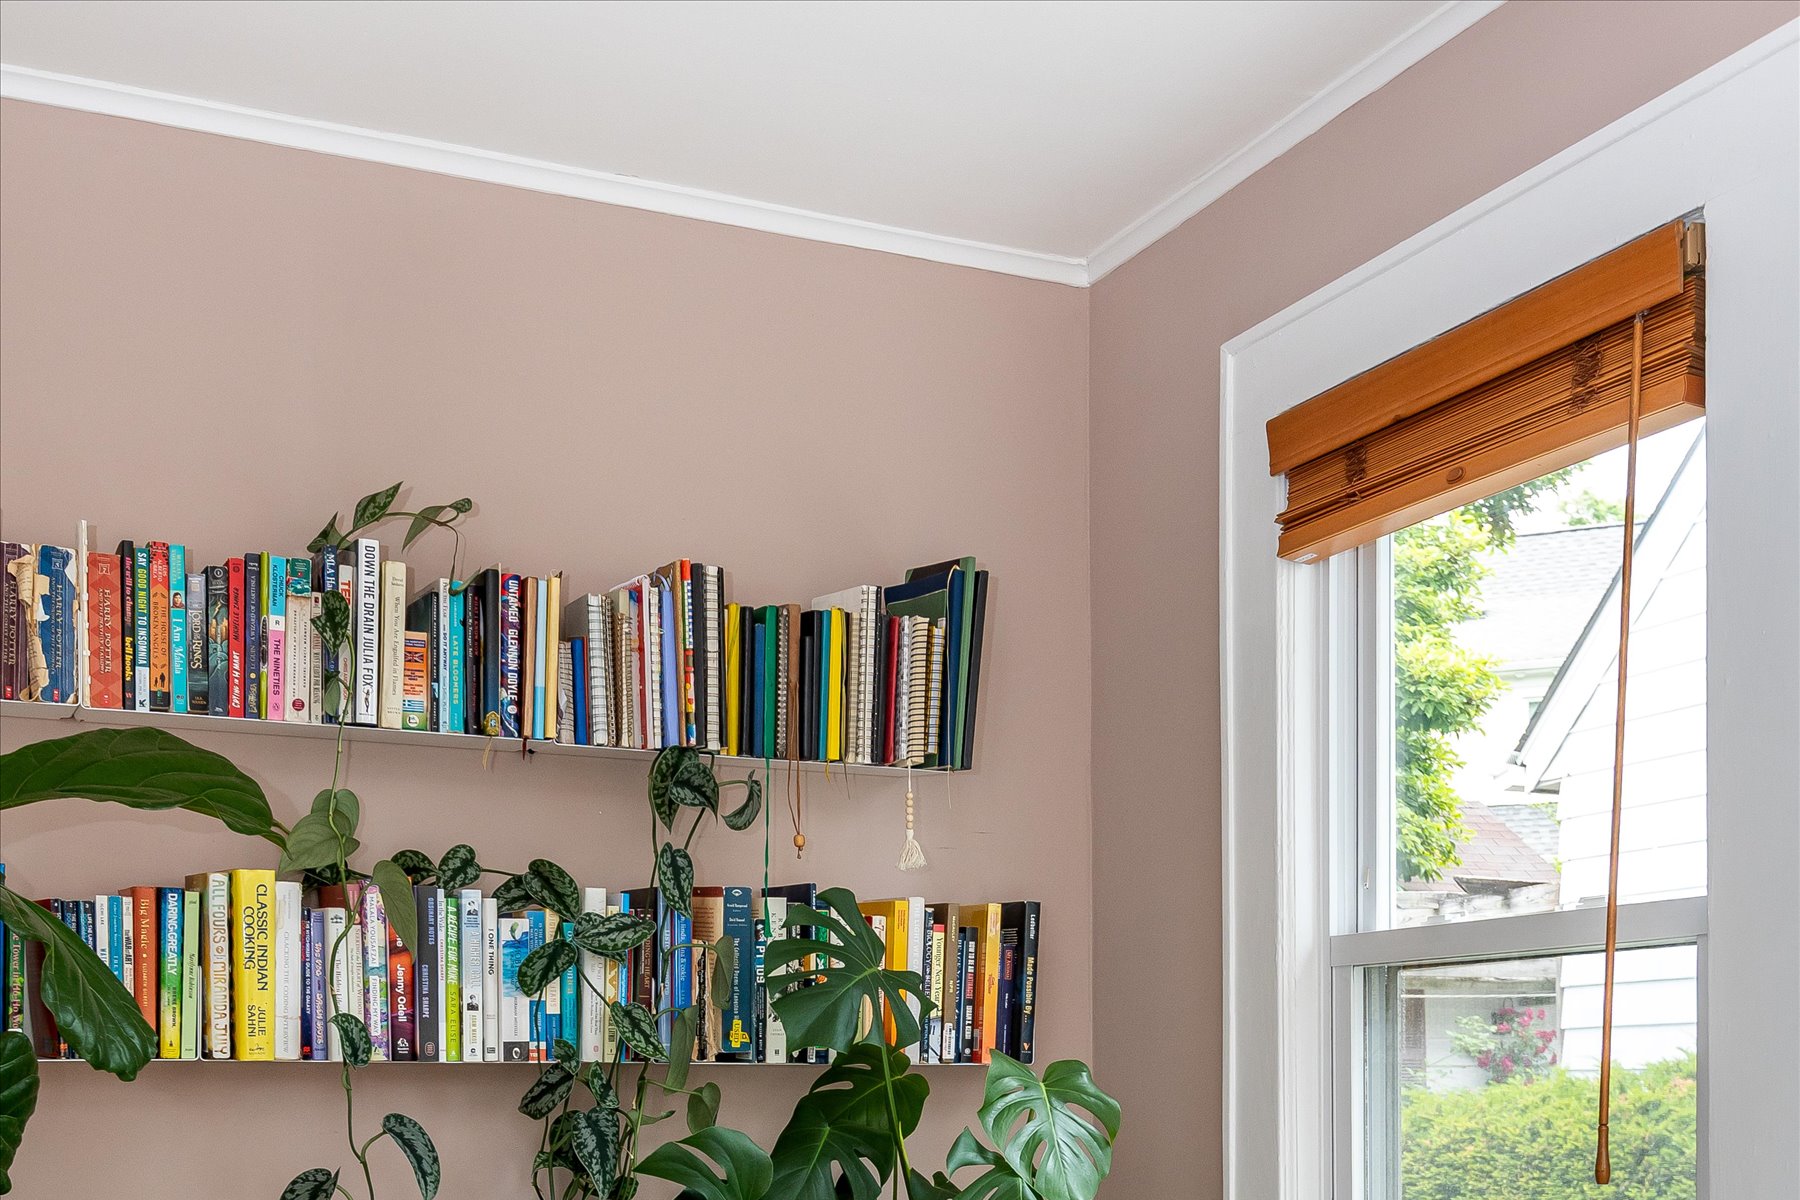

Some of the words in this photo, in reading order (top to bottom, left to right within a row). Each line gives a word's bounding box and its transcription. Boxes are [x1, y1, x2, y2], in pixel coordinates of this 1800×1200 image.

[137, 552, 147, 566] SAY
[326, 554, 335, 574] MLA
[364, 545, 376, 576] DOWN
[137, 568, 147, 589] GOOD
[364, 580, 375, 599] THE
[9, 580, 17, 621] HARRY
[104, 589, 112, 629] HARRY
[137, 591, 147, 613] NIGHT
[507, 580, 519, 622] UNTAMED
[138, 616, 147, 625] TO
[363, 602, 374, 634] DRAIN
[125, 636, 133, 654] bell
[137, 627, 148, 665] INSOMNIA
[172, 624, 182, 642] Am
[273, 639, 281, 656] THE
[55, 628, 63, 668] POTTER
[161, 648, 167, 657] OF
[172, 644, 184, 674] Malala
[189, 639, 202, 669] RINGS
[231, 651, 240, 670] MART
[363, 636, 374, 665] JULIA
[507, 629, 519, 670] GLENNON
[125, 654, 133, 682] hooks
[272, 657, 281, 696] NINETIES
[362, 667, 374, 687] FOX
[507, 672, 518, 701] DOYLE
[212, 879, 226, 901] ALL
[138, 898, 150, 916] Big
[167, 893, 178, 930] DARING
[256, 883, 268, 940] CLASSIC
[139, 918, 150, 950] Magic
[212, 904, 226, 944] FOURS
[243, 906, 256, 970] COOKING
[447, 914, 457, 944] RECIPE
[12, 943, 21, 970] Tower
[167, 932, 177, 976] GREATLY
[448, 945, 457, 963] FOR
[471, 940, 481, 966] HIGHER
[914, 945, 920, 958] WE
[935, 937, 943, 967] Younger
[1027, 957, 1035, 975] Made
[257, 944, 269, 992] INDIAN
[395, 964, 405, 994] Jenny
[448, 964, 458, 985] MORE
[471, 970, 481, 989] CALL
[968, 965, 975, 973] AN
[213, 961, 226, 1020] MIRANDA
[247, 1004, 257, 1038] SAHNI
[257, 1005, 267, 1036] JULIE
[372, 1008, 378, 1017] MY
[397, 995, 407, 1022] Odell
[422, 996, 430, 1019] SHARPE
[214, 1023, 227, 1055] JULY
